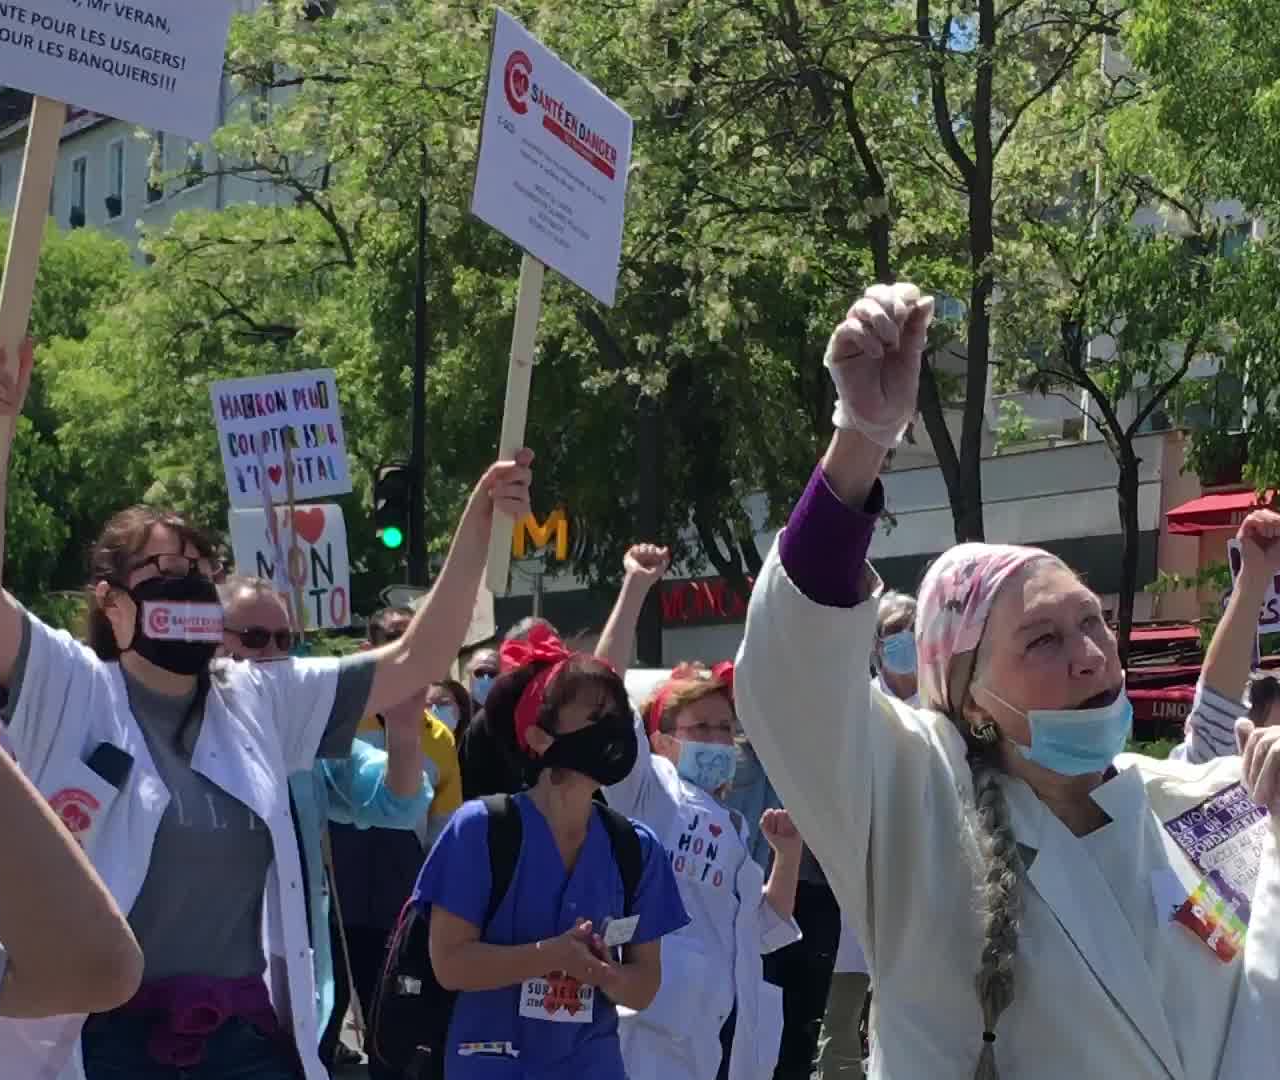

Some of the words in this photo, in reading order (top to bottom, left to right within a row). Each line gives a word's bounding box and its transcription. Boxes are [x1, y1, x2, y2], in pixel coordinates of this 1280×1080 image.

[30, 12, 76, 39] POUR
[80, 29, 106, 48] LES
[110, 38, 186, 70] USAGERS!
[116, 5, 170, 34] VERAN,
[38, 39, 63, 59] LES
[68, 47, 177, 92] BANQUIERS!!!
[513, 505, 569, 562] M
